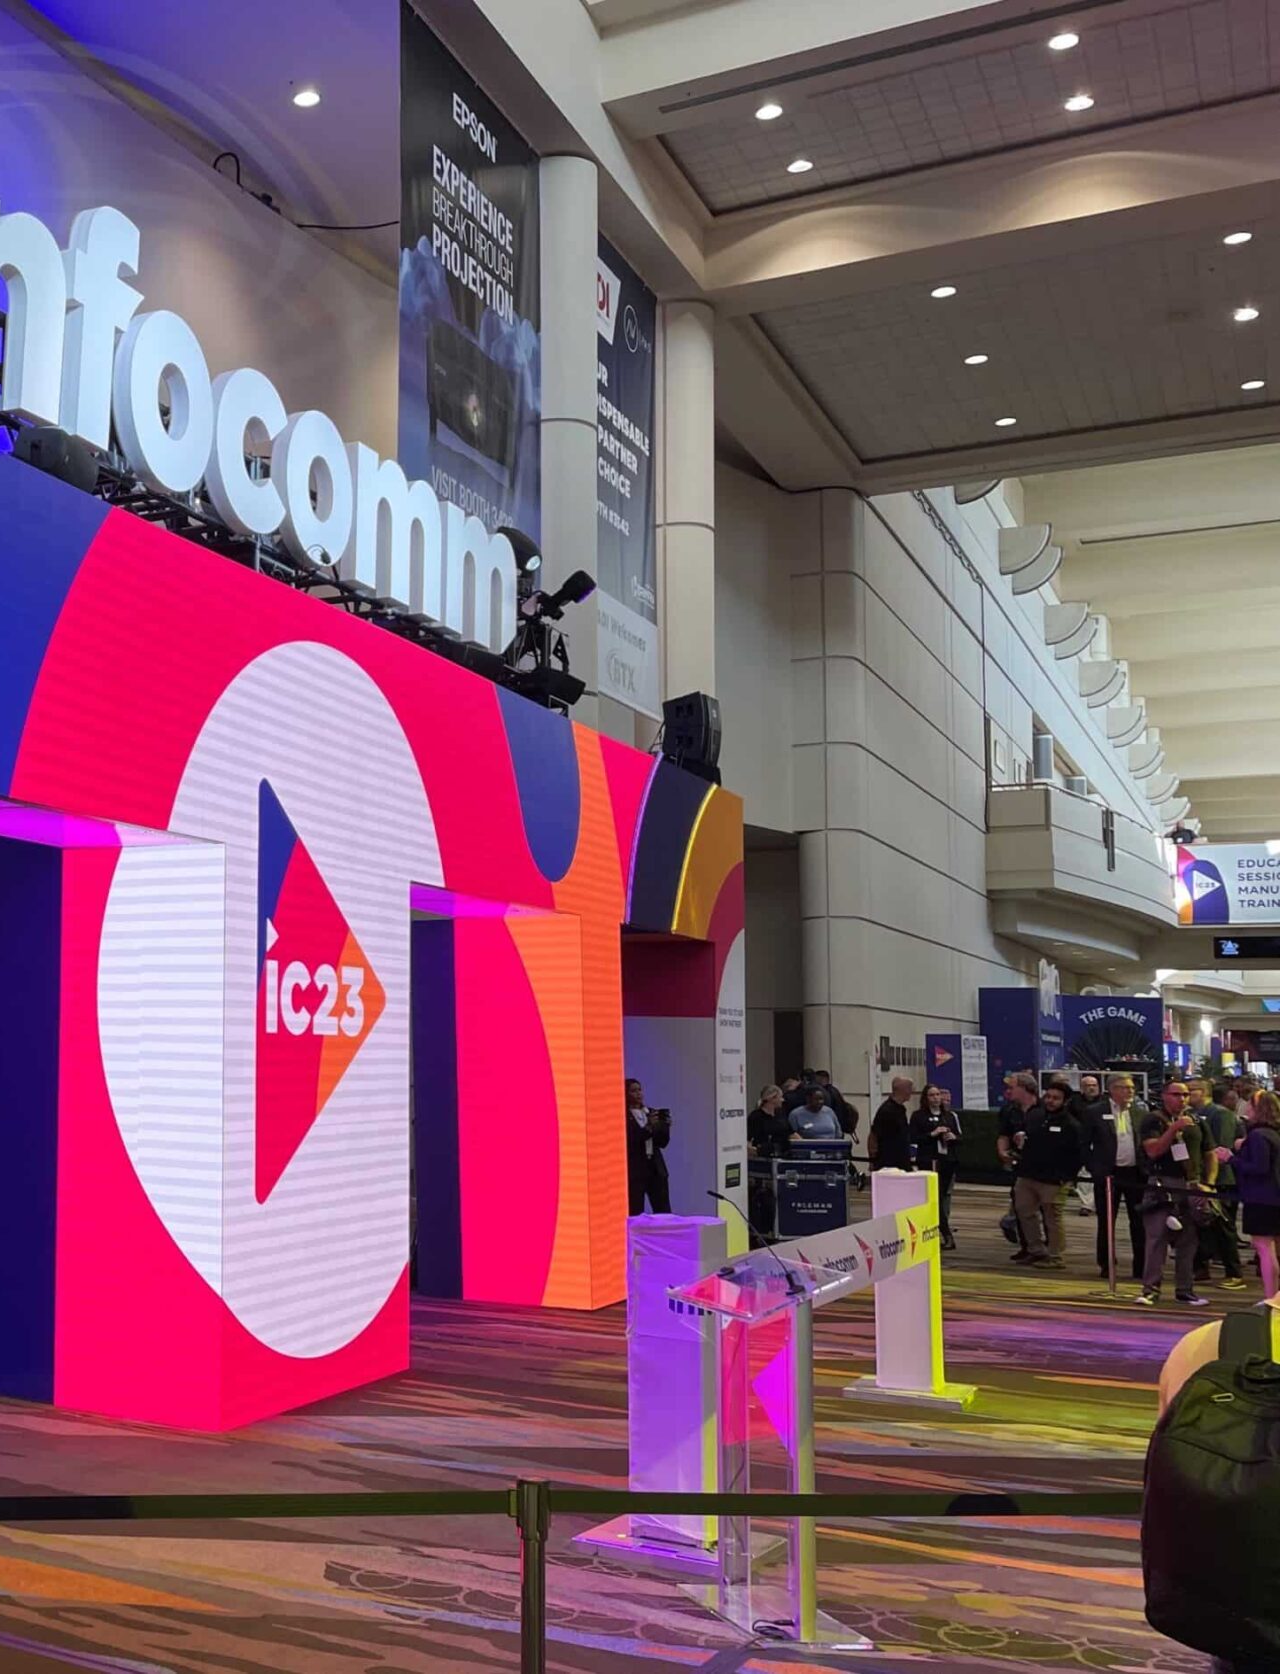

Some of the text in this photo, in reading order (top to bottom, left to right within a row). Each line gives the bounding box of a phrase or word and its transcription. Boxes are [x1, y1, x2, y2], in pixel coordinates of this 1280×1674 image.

[453, 91, 496, 163] EPSON
[433, 144, 513, 254] EXPERIENCE
[433, 186, 513, 289] BREAKTHROUGH
[433, 223, 513, 325] PROJECTION
[597, 392, 650, 457] ISPENSABLE
[598, 424, 638, 475] PARTNER
[432, 465, 457, 504] VISIT
[459, 483, 490, 528] BOOTH
[598, 457, 631, 498] CHOICE
[1238, 885, 1280, 895] MANU
[1238, 899, 1280, 909] TRAIN
[1079, 1005, 1147, 1027] THE GAME
